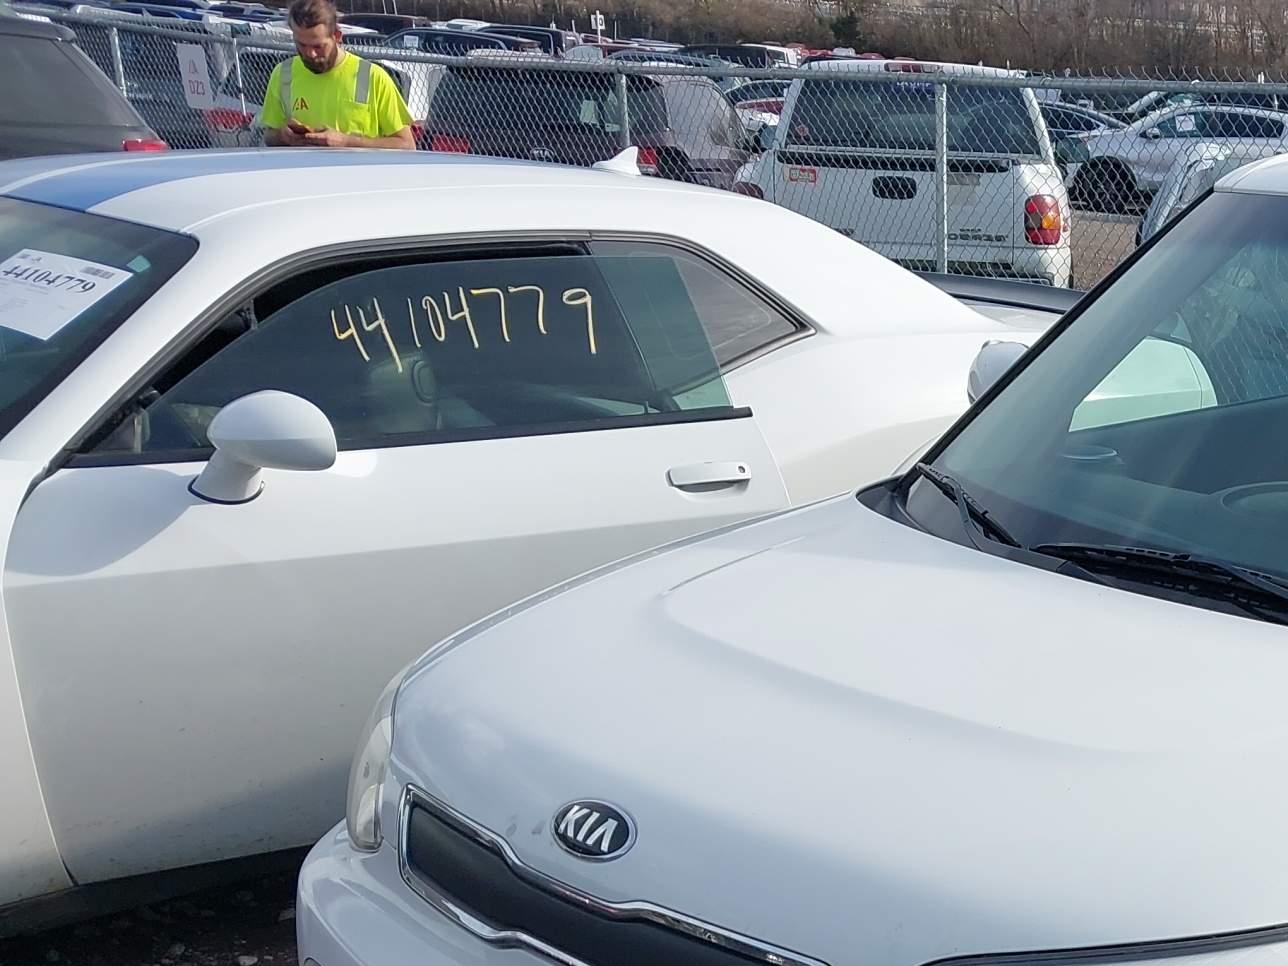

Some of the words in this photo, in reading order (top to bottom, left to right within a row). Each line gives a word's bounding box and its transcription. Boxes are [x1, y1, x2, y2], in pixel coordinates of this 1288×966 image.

[2, 264, 97, 293] 44104779
[330, 285, 597, 373] 44104779
[558, 804, 619, 853] KIA
